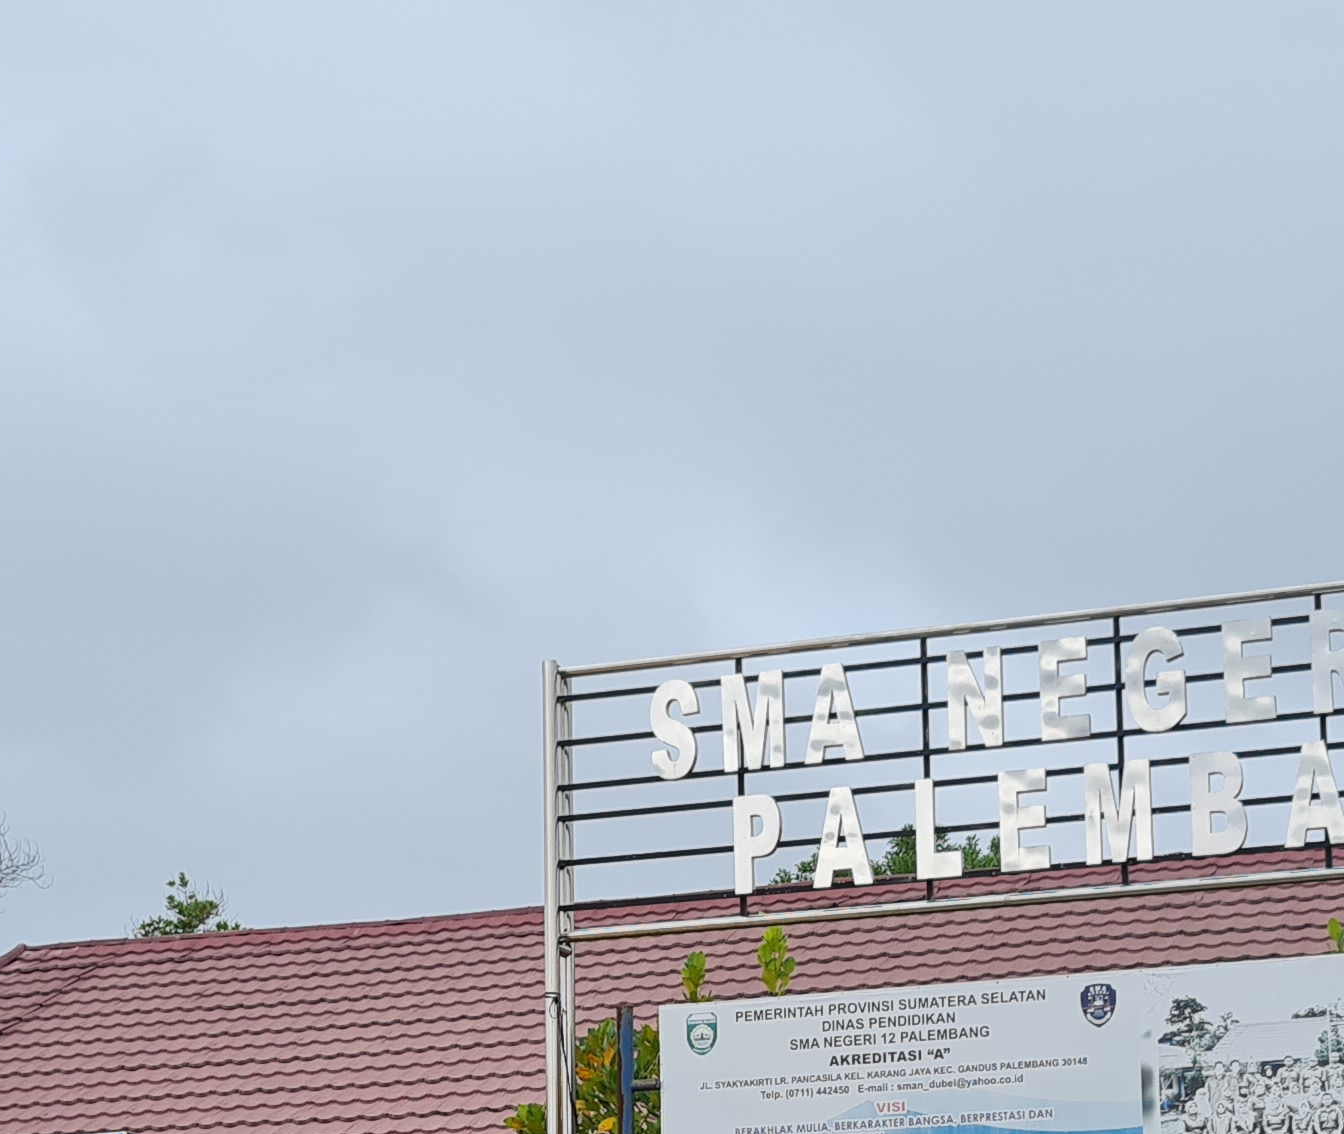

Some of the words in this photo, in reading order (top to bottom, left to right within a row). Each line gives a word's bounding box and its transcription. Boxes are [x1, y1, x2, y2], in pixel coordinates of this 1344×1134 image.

[651, 662, 864, 781] SMA
[735, 1005, 823, 1022] PEMERINTAH
[829, 1000, 894, 1015] PROVINSI
[899, 994, 977, 1010] SUMATERA
[981, 989, 1046, 1004] SELATAN
[822, 1018, 864, 1032] DINAS
[869, 1012, 956, 1029] PENDIDIKAN
[790, 1038, 820, 1050] SMA
[824, 1034, 876, 1048] NEGERI
[881, 1033, 895, 1044] 12
[900, 1026, 990, 1043] PALEMBANG
[829, 1050, 922, 1067] AKREDITASI
[715, 1078, 772, 1089] SYAKYAKIRTI
[774, 1077, 789, 1086] LR.
[791, 1073, 842, 1084] PANCASILA
[844, 1072, 864, 1081] KEL.
[867, 1068, 906, 1079] KARANG
[908, 1067, 931, 1076] JAYA
[933, 1066, 955, 1075] KEC.
[958, 1063, 998, 1073] GANDUS
[1000, 1059, 1059, 1070] PALEMBANG
[1061, 1057, 1088, 1066] 30148
[785, 1088, 814, 1100] (0711)
[816, 1086, 850, 1096] 442450
[858, 1083, 888, 1093] E-mail
[876, 1101, 906, 1113] VISI
[796, 1122, 831, 1133] MULIA,
[835, 1117, 905, 1131] BERKARAKTER
[908, 1114, 956, 1126] BANGSA,
[961, 1110, 1025, 1123] BERPRESTASI
[1028, 1109, 1053, 1119] DAN
